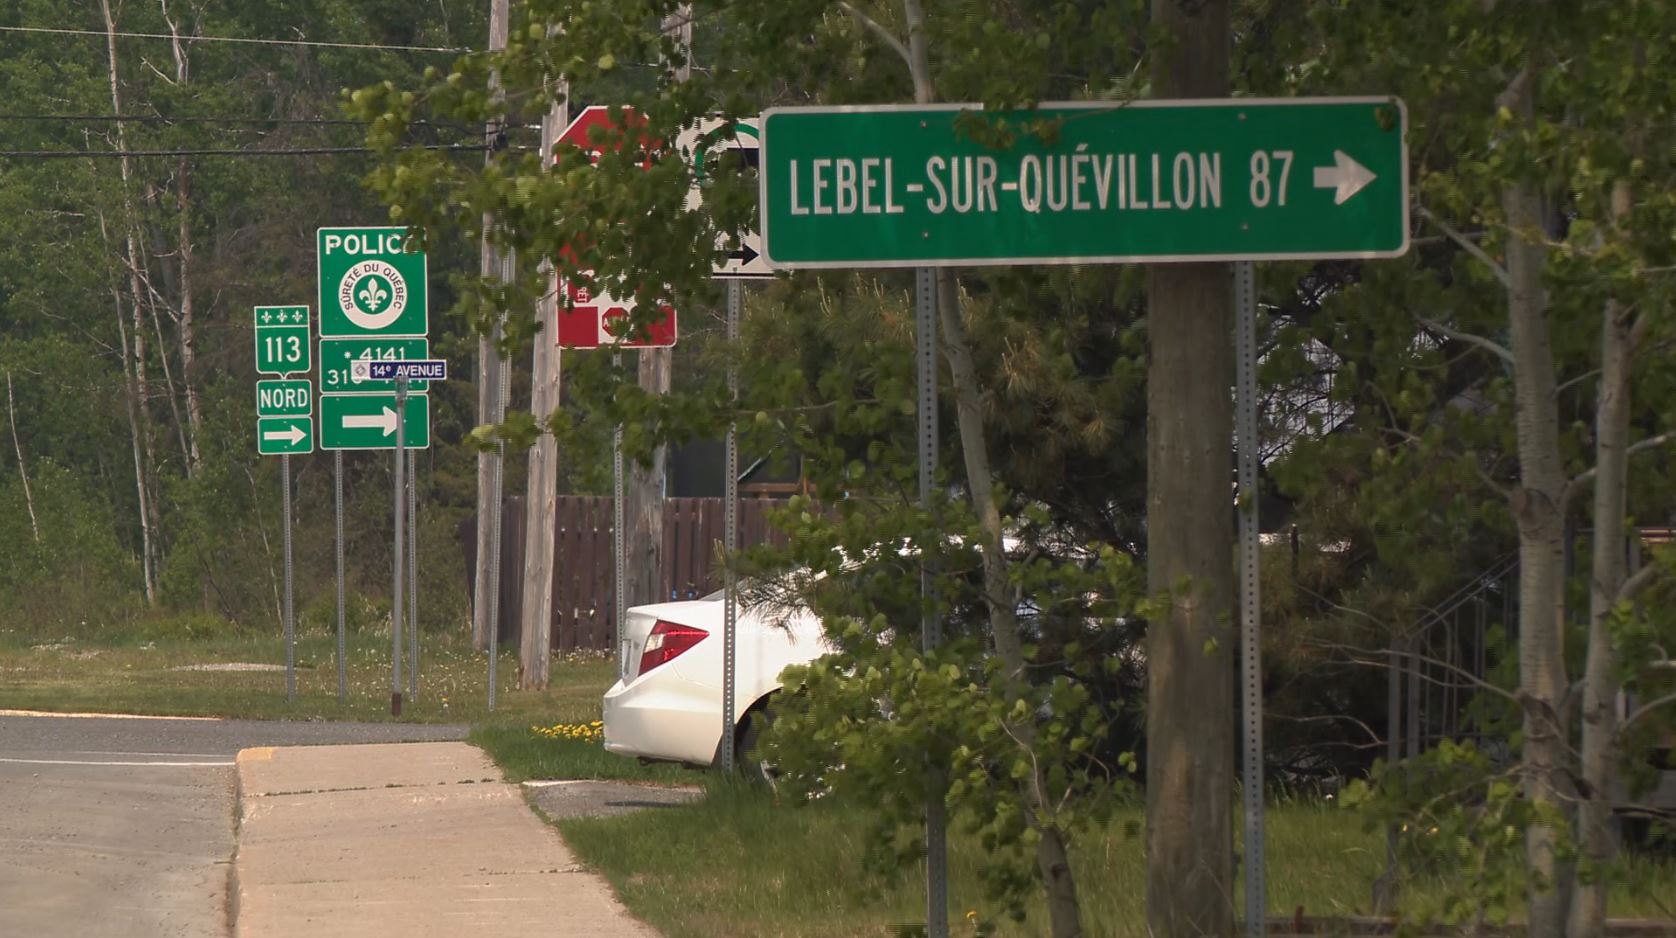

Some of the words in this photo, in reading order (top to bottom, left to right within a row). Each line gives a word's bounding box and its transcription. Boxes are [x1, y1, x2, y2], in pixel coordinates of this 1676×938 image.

[790, 143, 1222, 215] LEBEL-SUR-QUÉVILLON
[1249, 150, 1294, 208] 87
[363, 263, 380, 273] DU
[382, 267, 405, 310] QUÉBEC
[265, 336, 301, 363] 113
[396, 364, 443, 377] AVENUE
[260, 388, 308, 408] NORD
